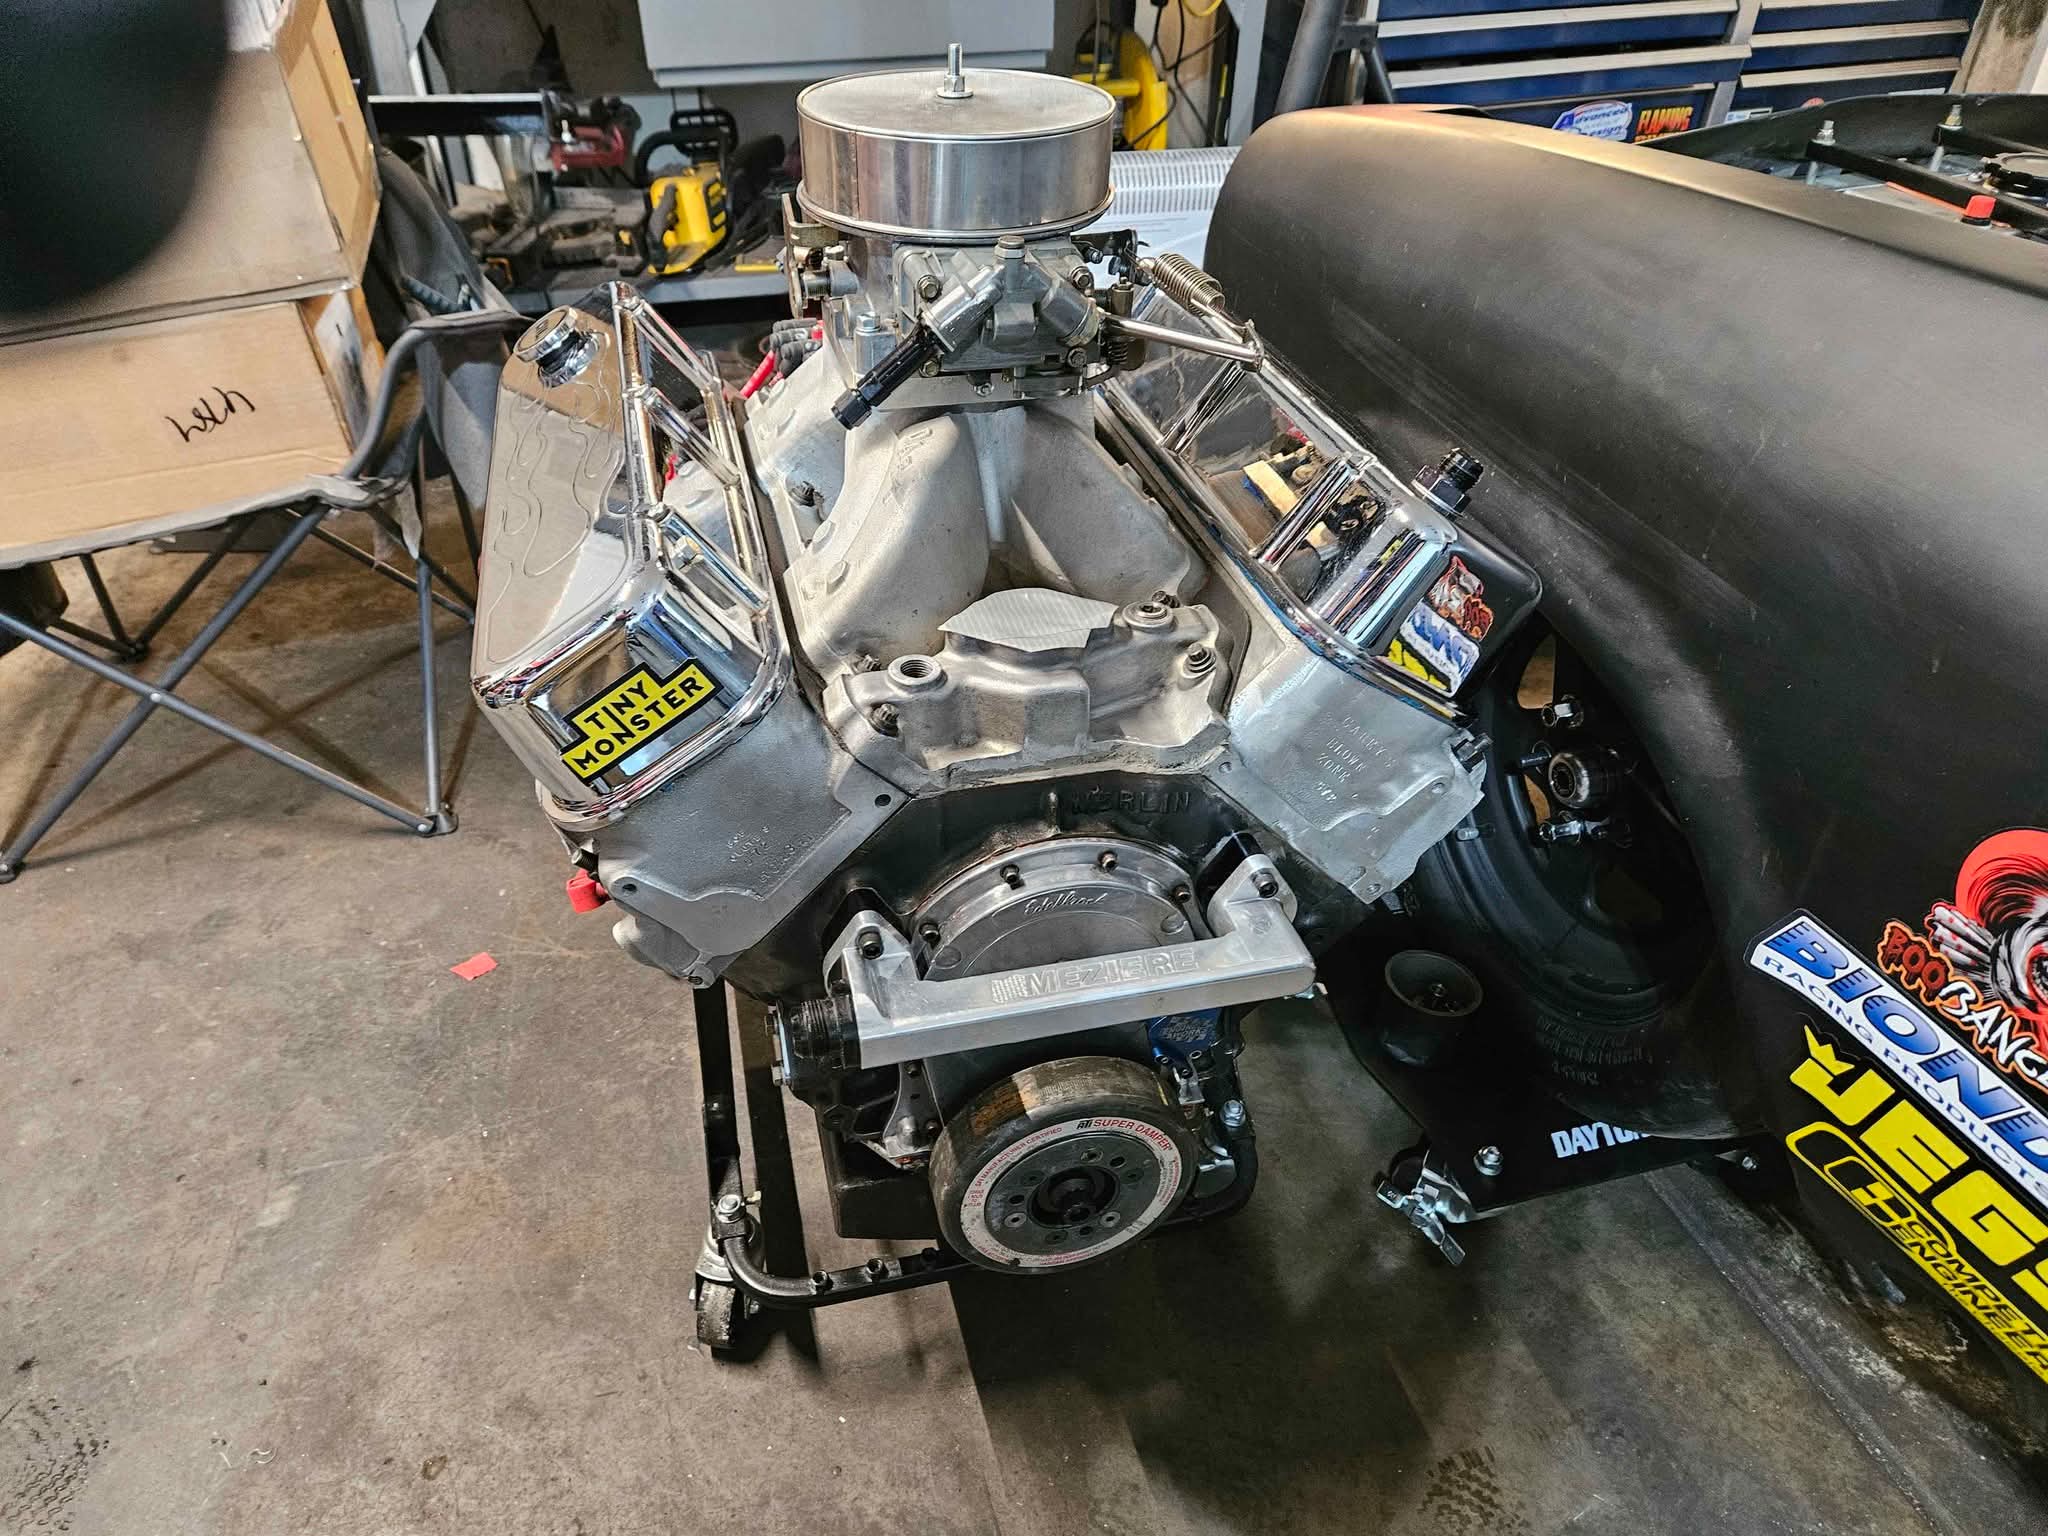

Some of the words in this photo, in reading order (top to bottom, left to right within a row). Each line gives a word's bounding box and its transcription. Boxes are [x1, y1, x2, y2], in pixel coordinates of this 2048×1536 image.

[1636, 106, 1694, 134] FLAMING
[572, 676, 705, 771] MONSTER
[583, 679, 649, 732] TINY
[1072, 790, 1190, 816] MERLIN
[1025, 947, 1200, 998] MEZIERE
[1763, 955, 1875, 1045] RACING
[1093, 1119, 1135, 1130] SUPER
[1135, 1124, 1172, 1152] DAMPER
